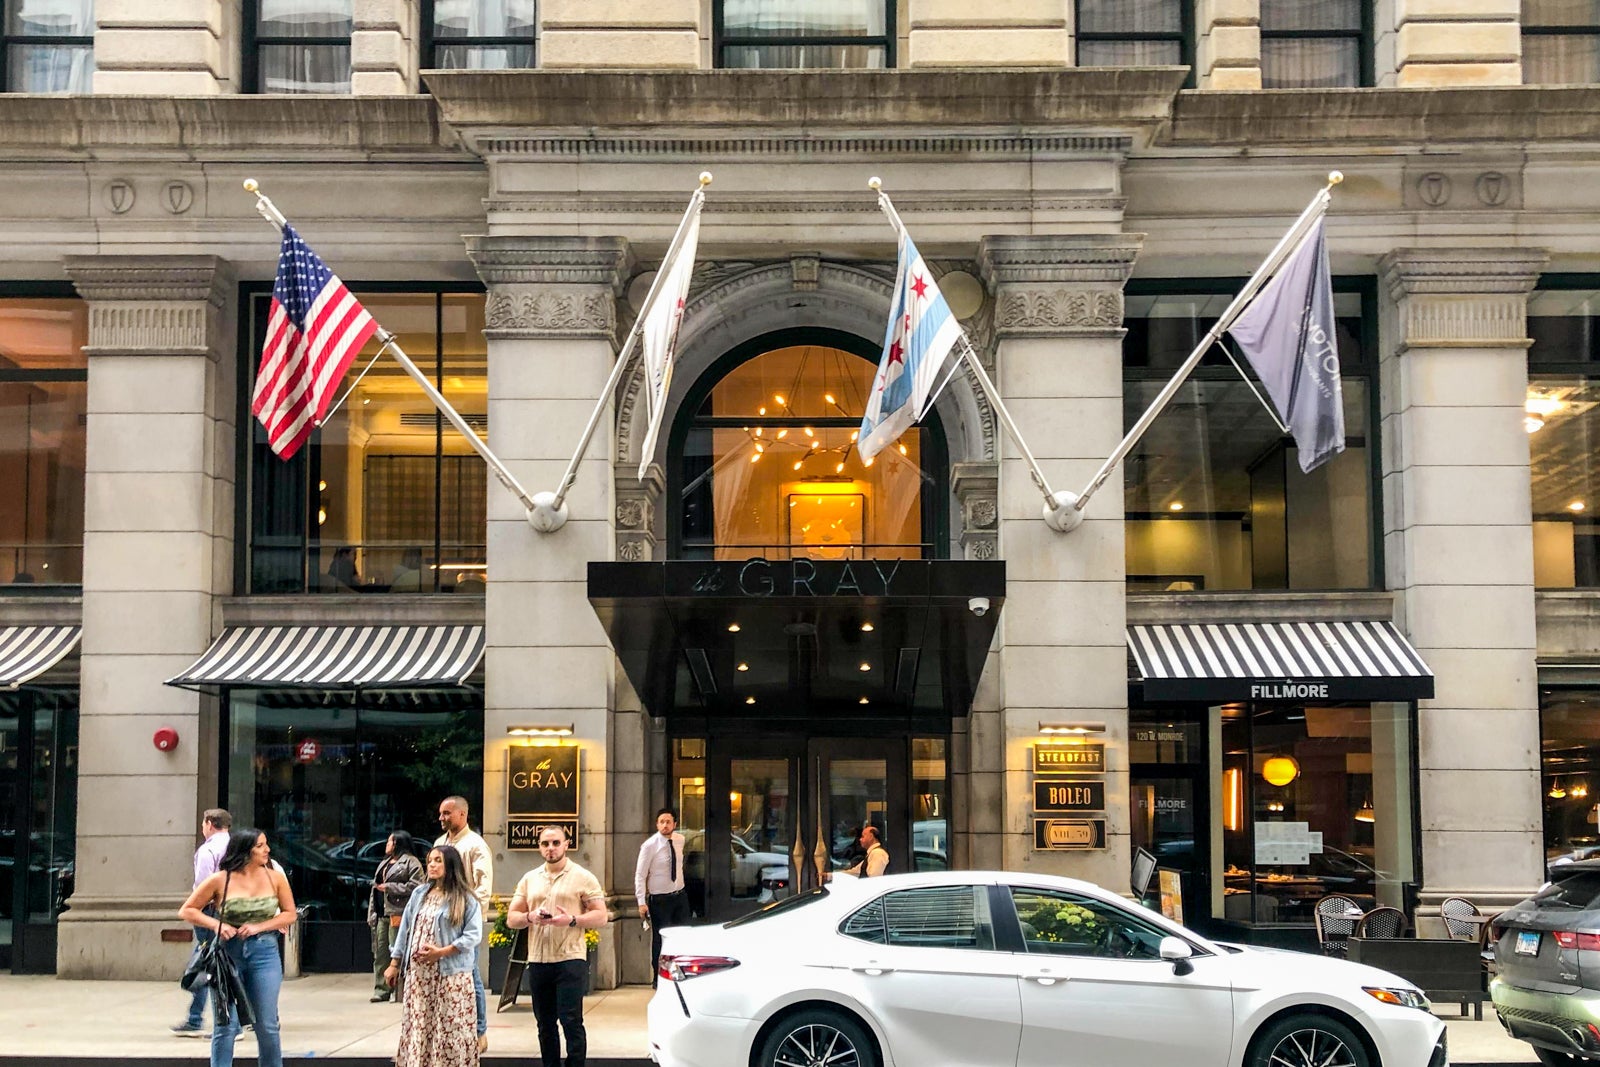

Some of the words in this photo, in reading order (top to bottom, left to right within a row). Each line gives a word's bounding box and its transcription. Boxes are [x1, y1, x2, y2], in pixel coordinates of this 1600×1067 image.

[739, 557, 901, 597] GRAY
[1251, 684, 1329, 698] FILLMORE
[1136, 732, 1148, 741] 120
[1158, 732, 1184, 741] MONROE
[535, 758, 552, 770] the
[1039, 753, 1100, 763] STEADFAST
[512, 772, 573, 789] GRAY
[1049, 787, 1091, 805] BOLEO
[1139, 800, 1187, 809] FILMORE
[512, 825, 573, 837] KIMPN
